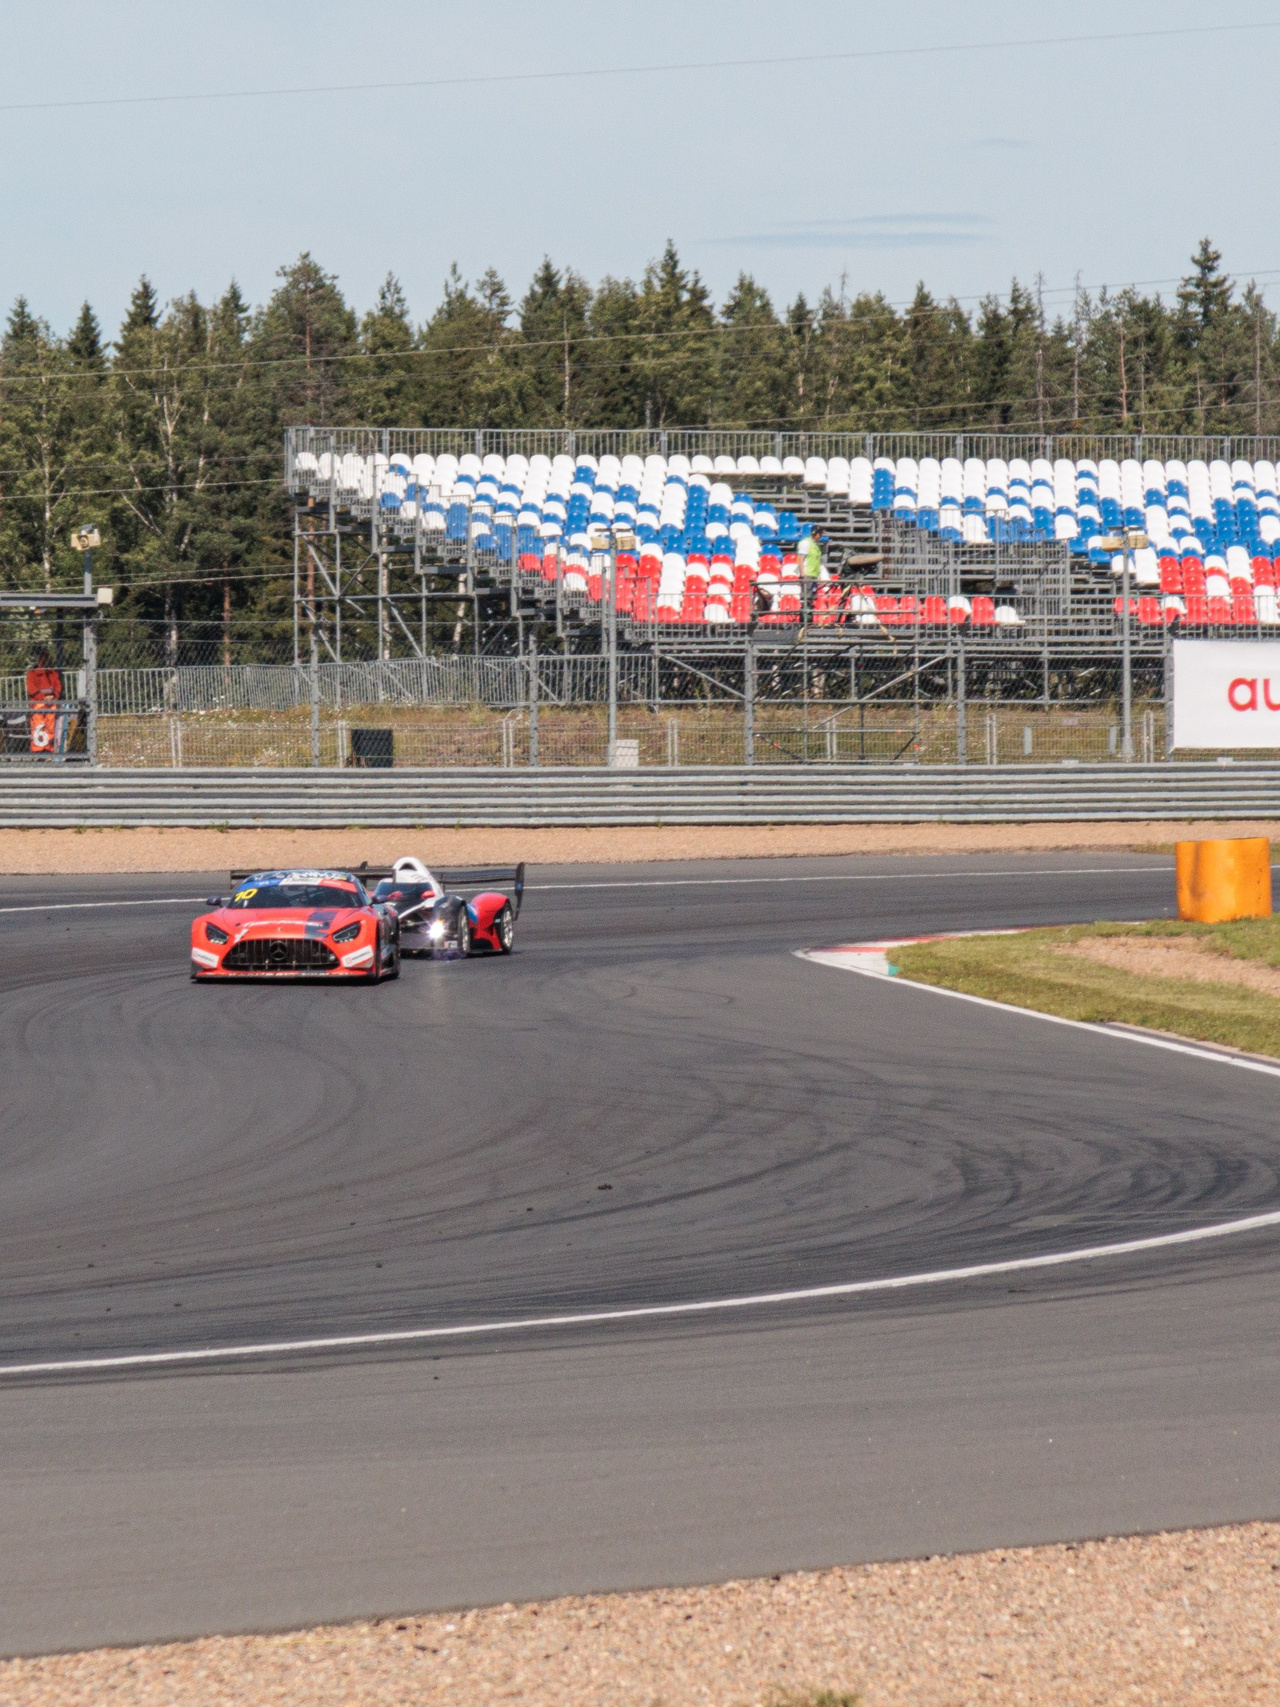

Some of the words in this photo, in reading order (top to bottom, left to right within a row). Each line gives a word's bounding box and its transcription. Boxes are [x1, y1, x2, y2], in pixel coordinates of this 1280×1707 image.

[1228, 677, 1280, 712] au
[33, 722, 49, 747] 6
[234, 888, 258, 902] 10
